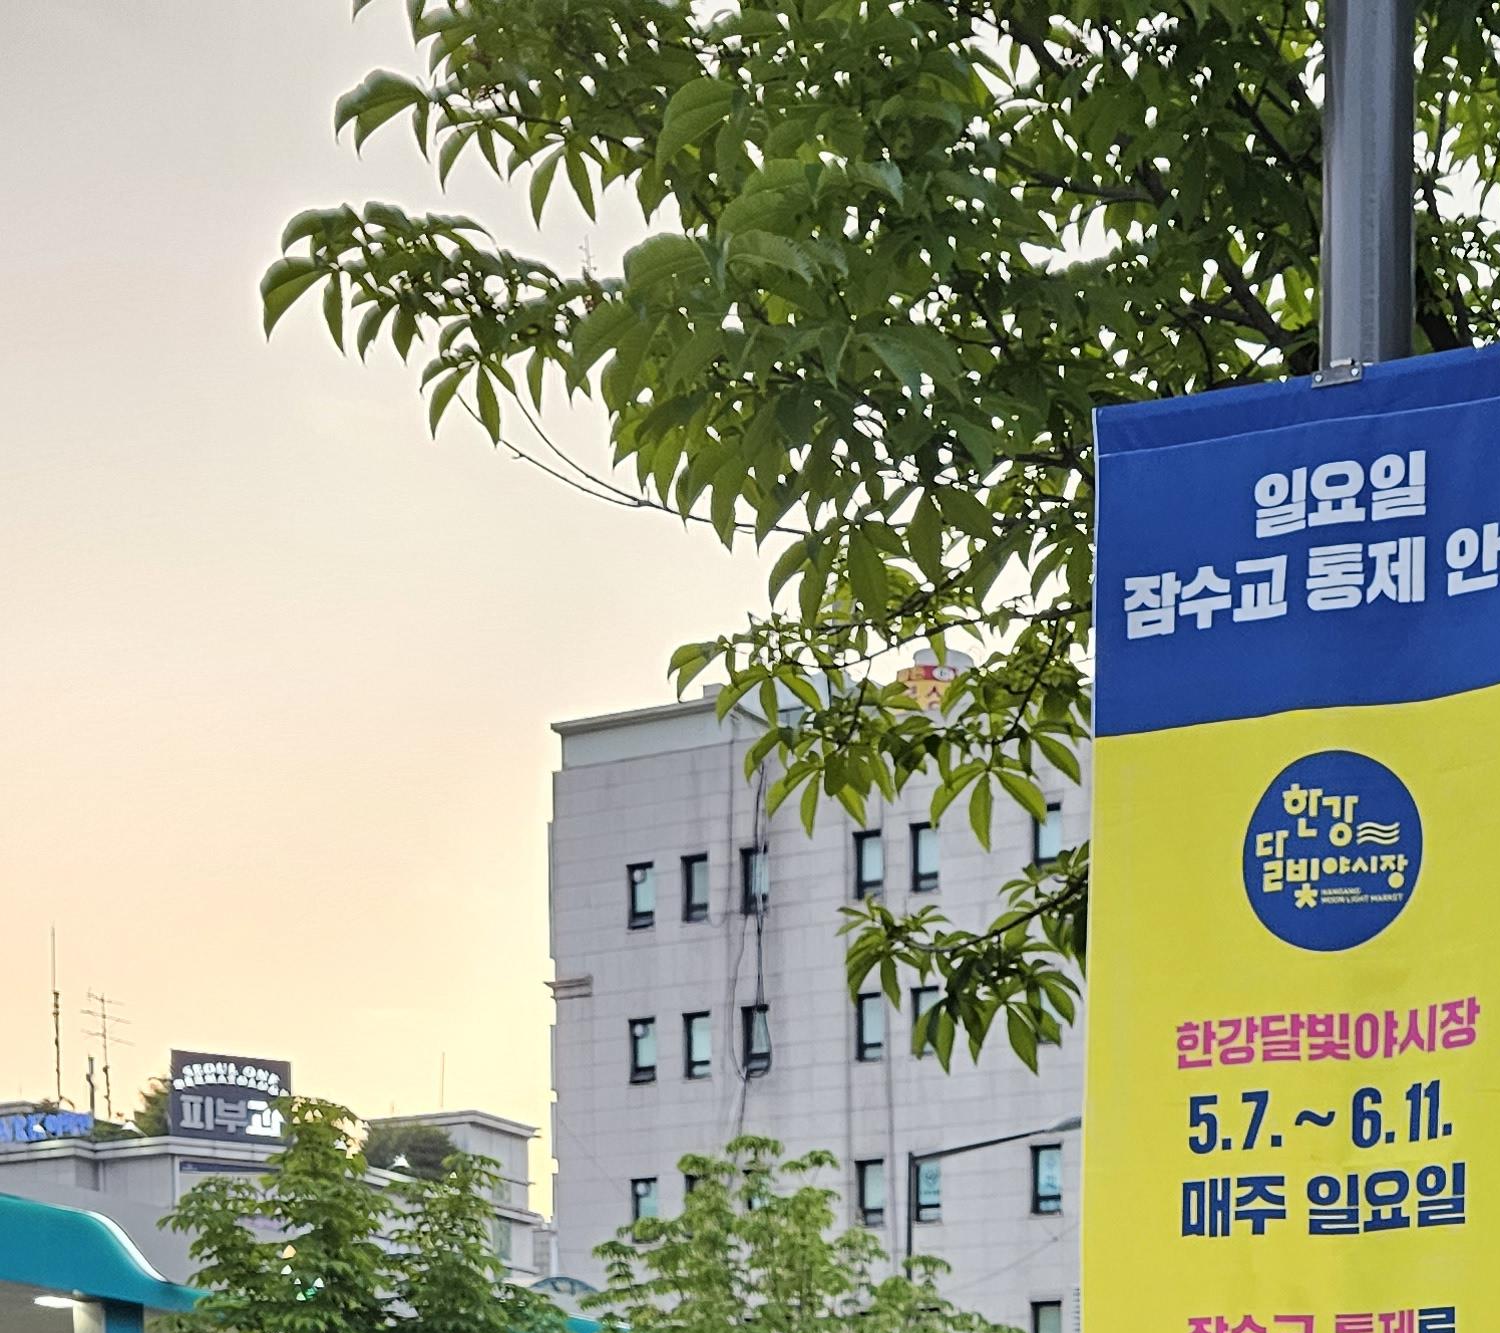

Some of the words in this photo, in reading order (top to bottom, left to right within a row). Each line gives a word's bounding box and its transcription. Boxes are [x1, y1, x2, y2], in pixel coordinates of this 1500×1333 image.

[1255, 451, 1426, 538] 일요일
[1125, 555, 1287, 639] 잠수교
[1307, 537, 1425, 610] 통제
[1283, 783, 1359, 847] 한강
[1177, 997, 1480, 1069] 한강달빛야시장
[179, 1094, 286, 1137] 피부과
[1189, 1091, 1282, 1154] 5.7.
[1352, 1080, 1452, 1148] 6.11.
[1182, 1176, 1286, 1237] 매주
[1307, 1162, 1465, 1235] 일요일
